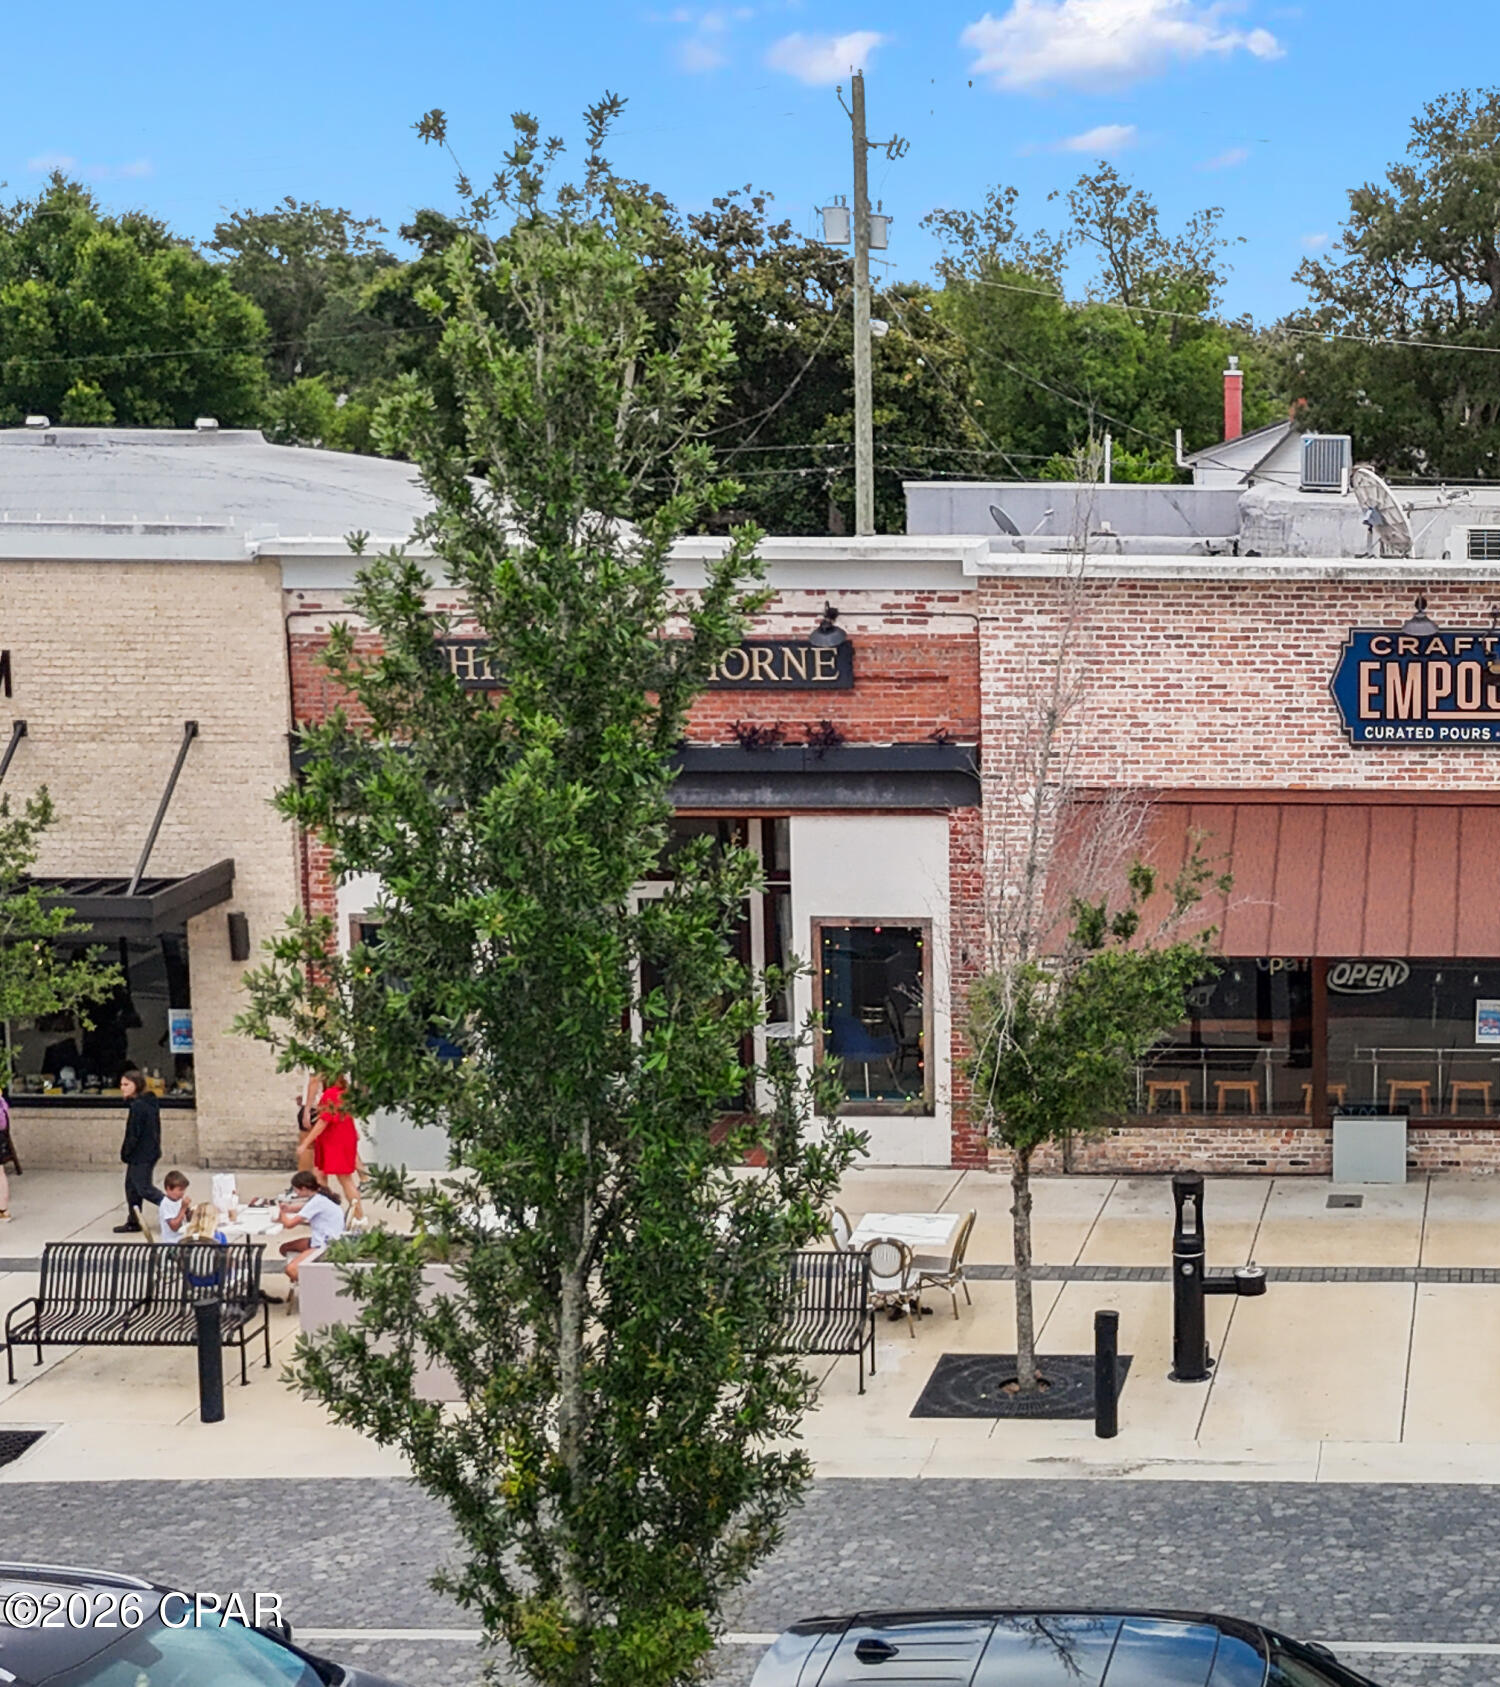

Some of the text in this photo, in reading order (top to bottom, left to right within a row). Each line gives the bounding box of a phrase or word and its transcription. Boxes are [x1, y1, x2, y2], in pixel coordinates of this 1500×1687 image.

[1369, 636, 1500, 656] CRAFT
[1364, 726, 1434, 740] CURATED
[1439, 726, 1491, 741] POURS
[1332, 962, 1400, 988] OPEN
